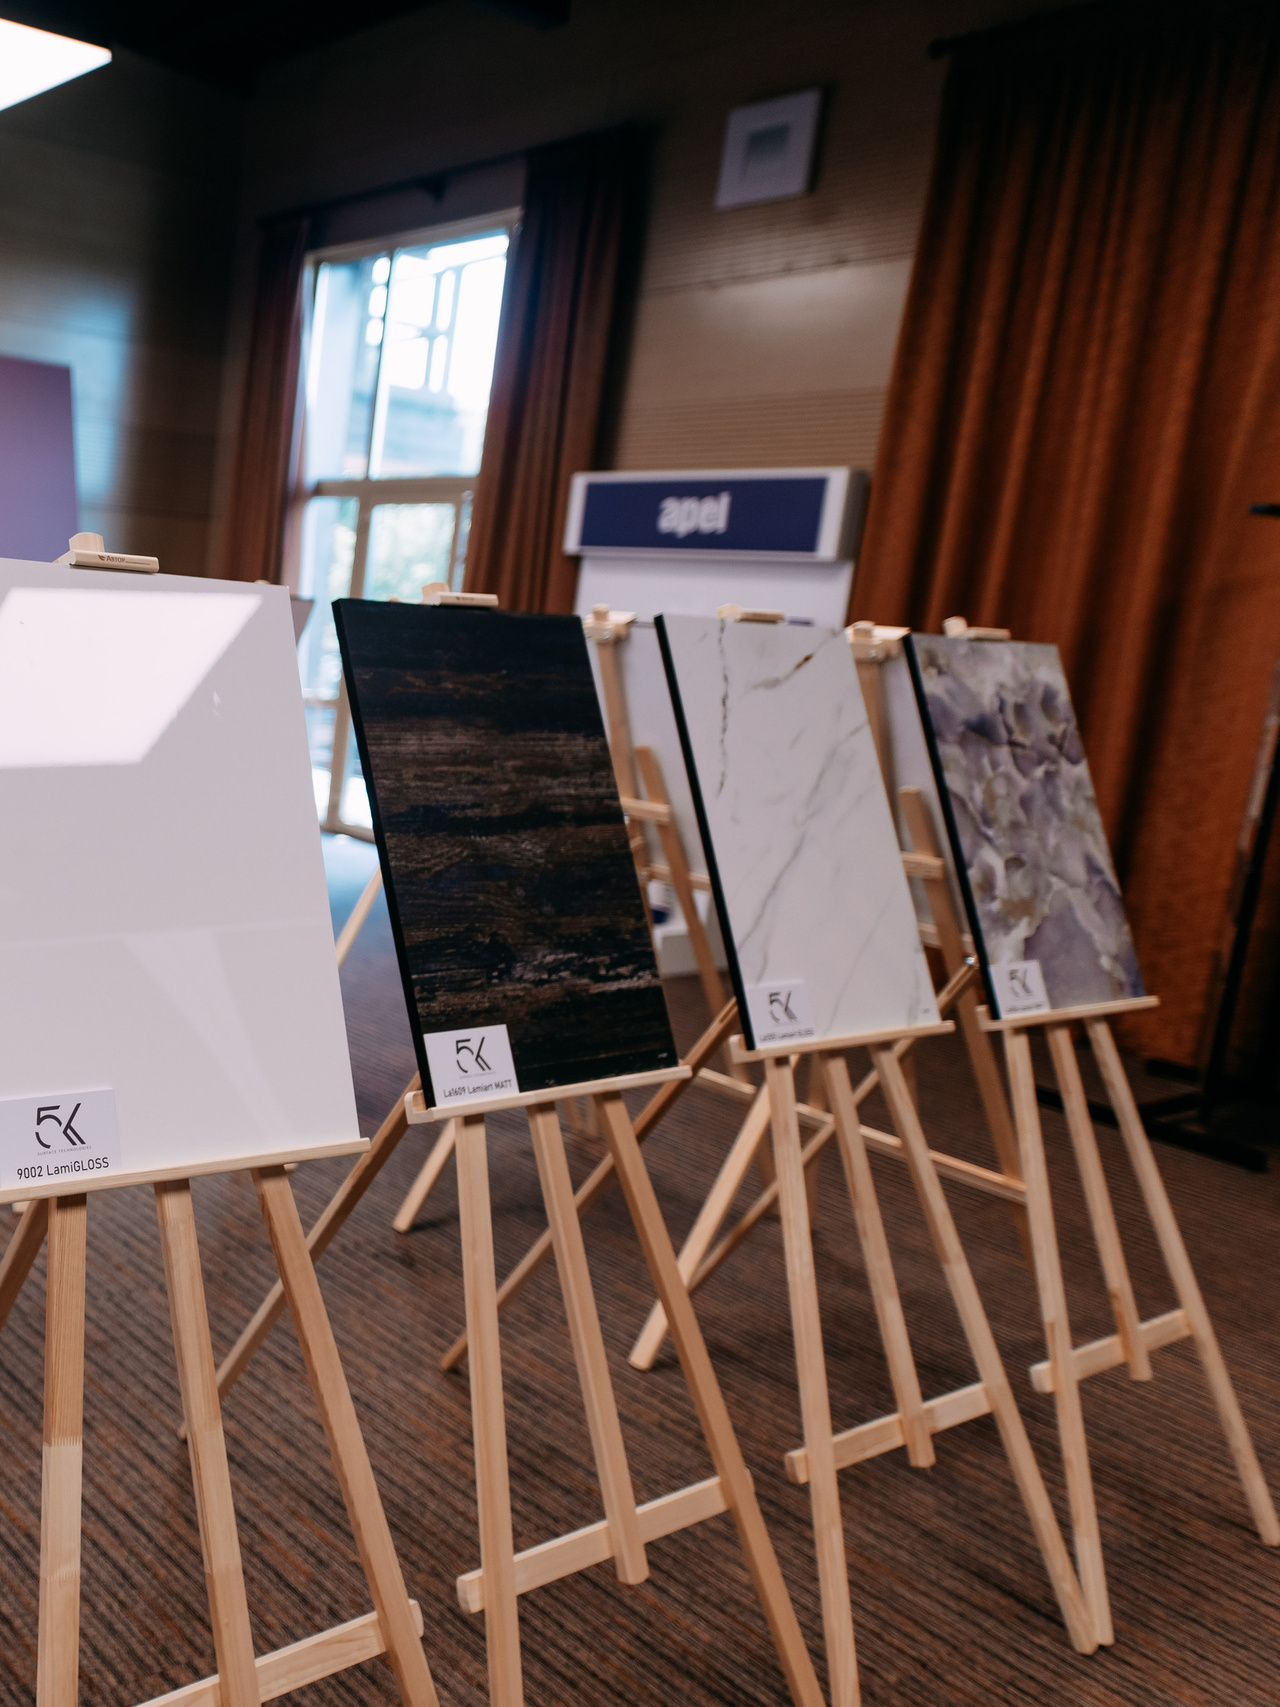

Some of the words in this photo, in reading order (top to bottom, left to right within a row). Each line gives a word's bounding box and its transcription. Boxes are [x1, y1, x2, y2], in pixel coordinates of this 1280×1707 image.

[657, 491, 731, 538] apel
[768, 991, 798, 1023] 5K
[455, 1036, 492, 1074] 5K
[494, 1079, 512, 1090] MATT
[34, 1102, 87, 1149] 5K
[58, 1145, 92, 1153] TECHNOLOGIES
[16, 1165, 44, 1180] 9002
[46, 1156, 110, 1176] LamiGLOSS
